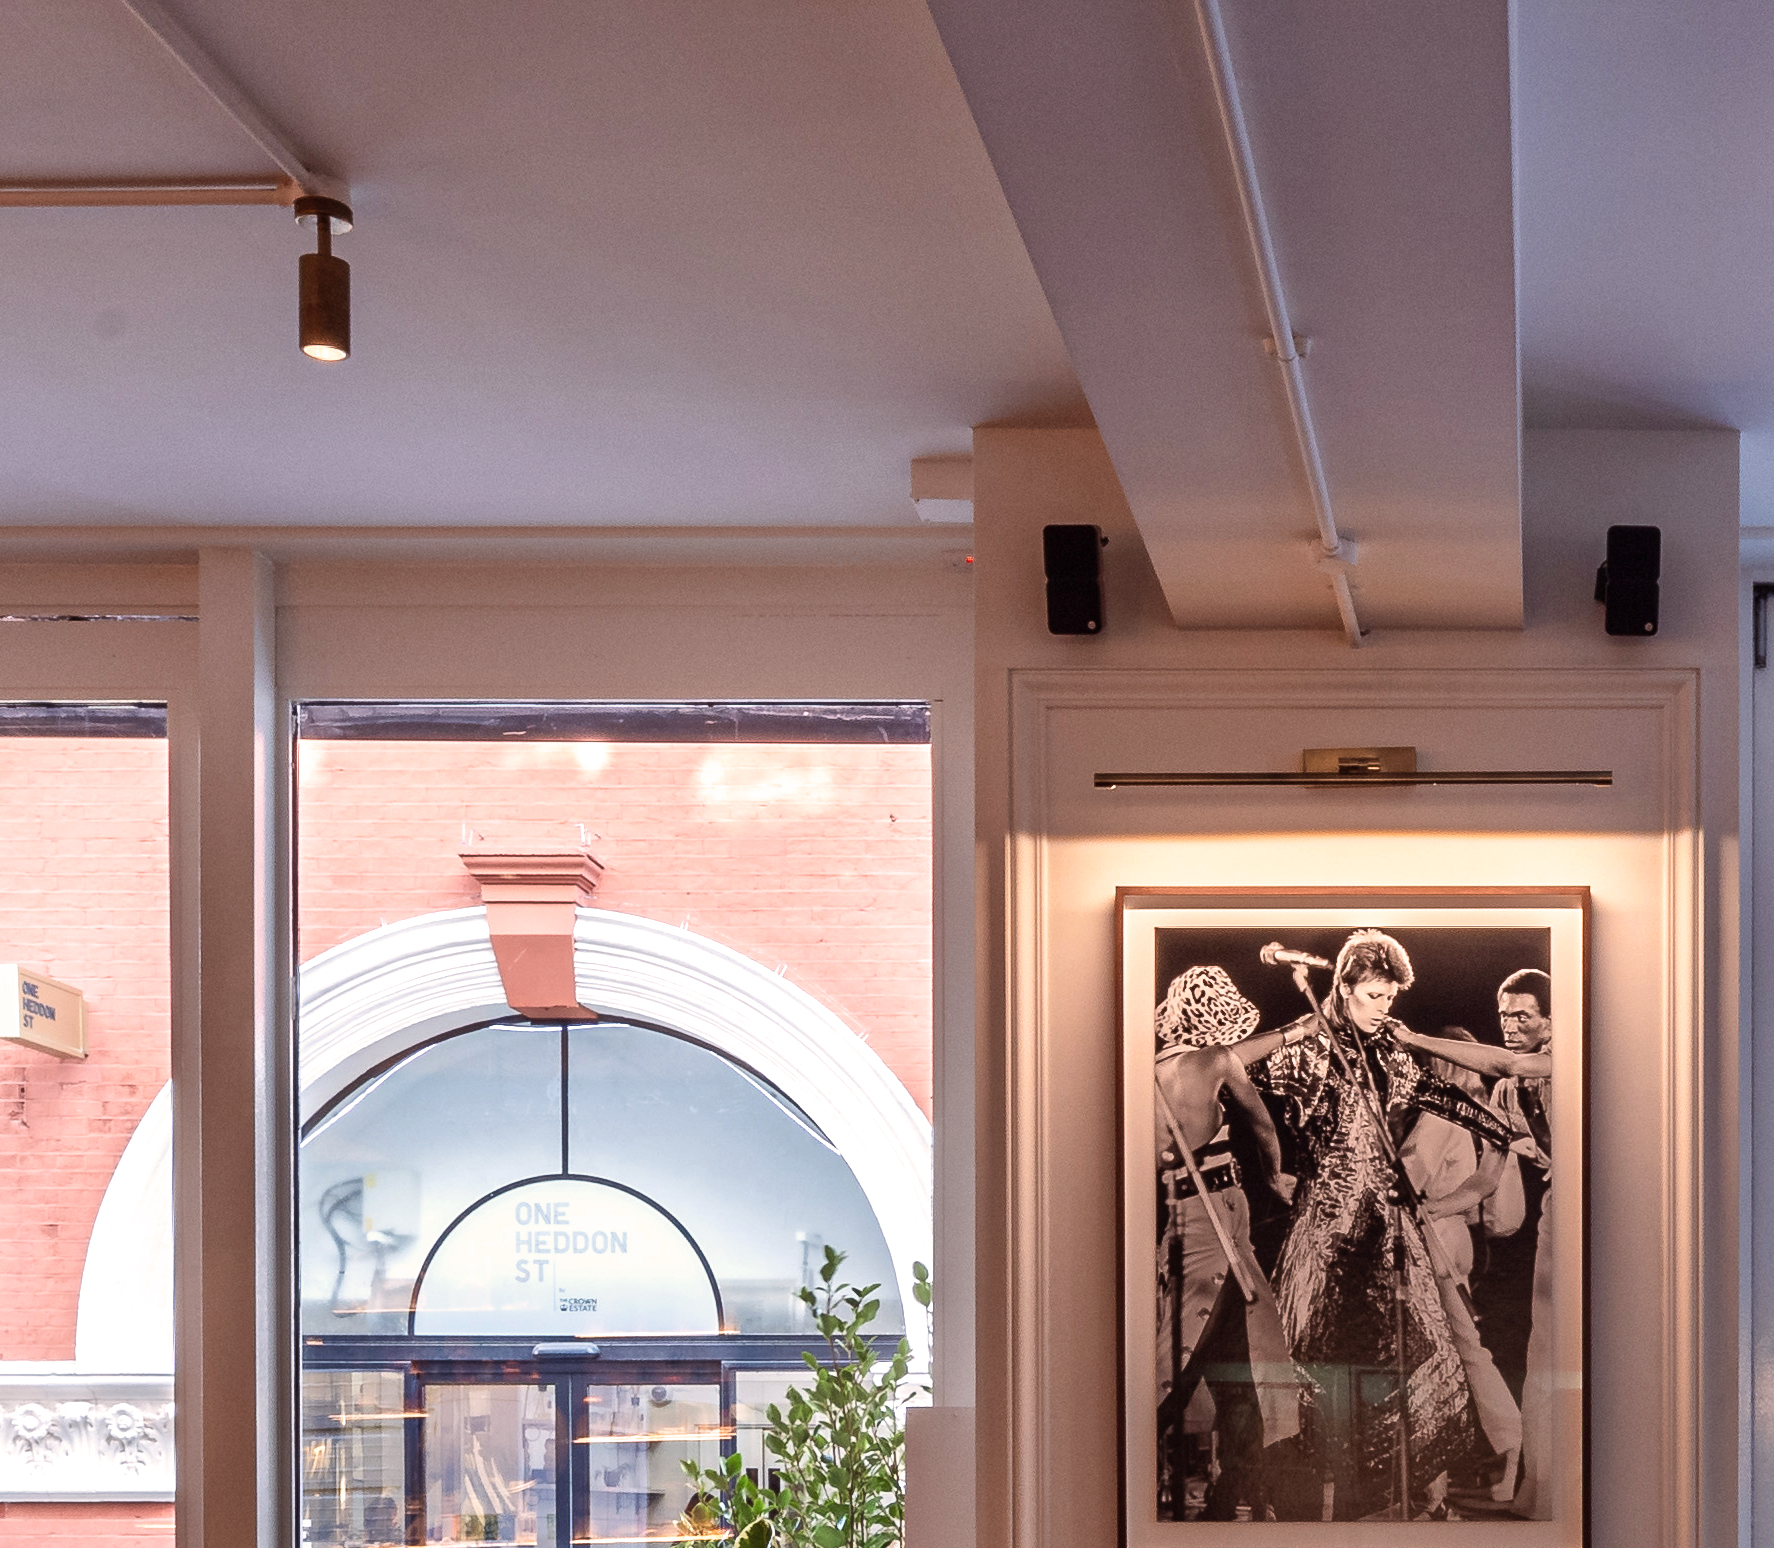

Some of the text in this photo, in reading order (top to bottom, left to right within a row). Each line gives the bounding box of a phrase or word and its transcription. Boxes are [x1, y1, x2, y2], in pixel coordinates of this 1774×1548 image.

[22, 981, 39, 999] ONE
[22, 997, 56, 1021] HEDDON
[23, 1014, 34, 1029] ST
[515, 1201, 570, 1226] ONE
[515, 1230, 628, 1254] HEDDON
[515, 1258, 550, 1283] ST
[568, 1304, 598, 1312] ESTATE
